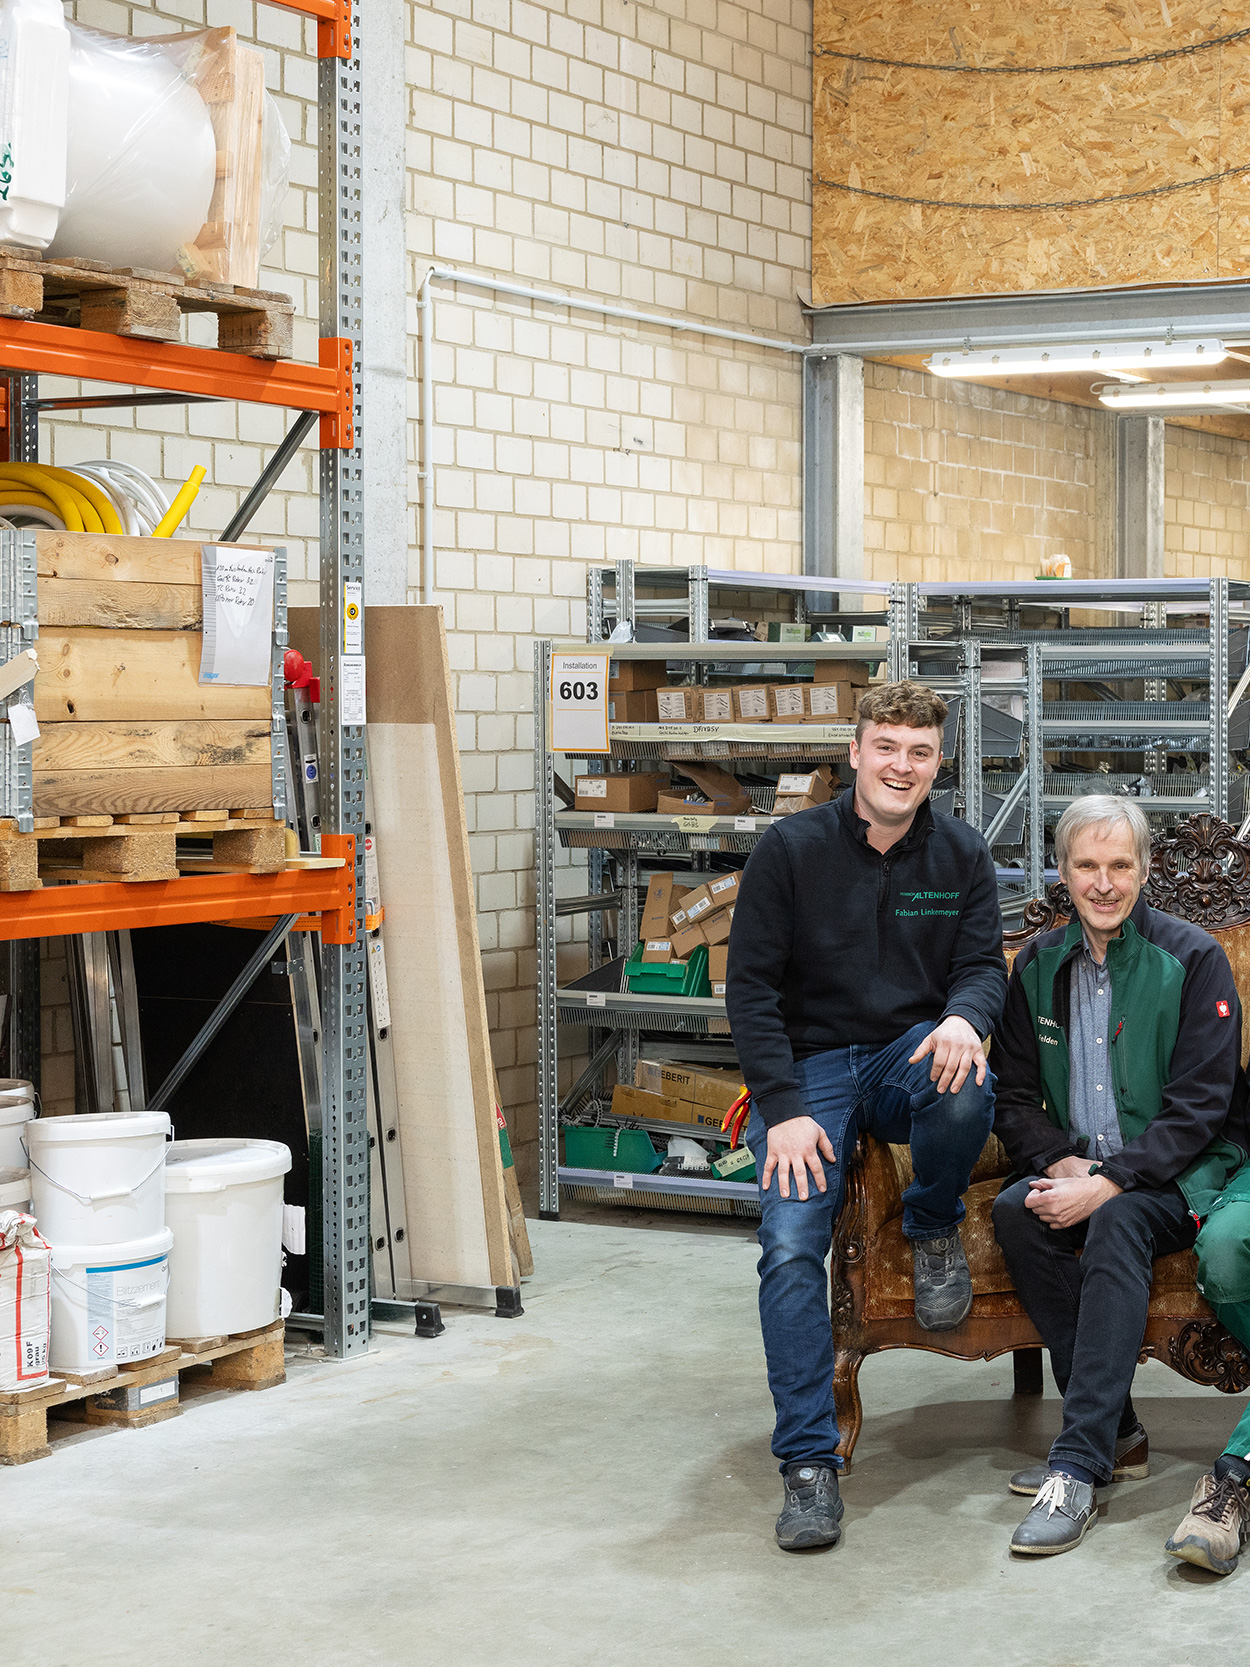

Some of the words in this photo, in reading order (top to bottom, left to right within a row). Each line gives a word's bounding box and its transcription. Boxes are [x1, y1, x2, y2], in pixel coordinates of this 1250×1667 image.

[562, 661, 598, 670] Installation
[559, 681, 599, 700] 603
[895, 909, 919, 917] Fabian
[920, 908, 959, 917] Linkemeyer
